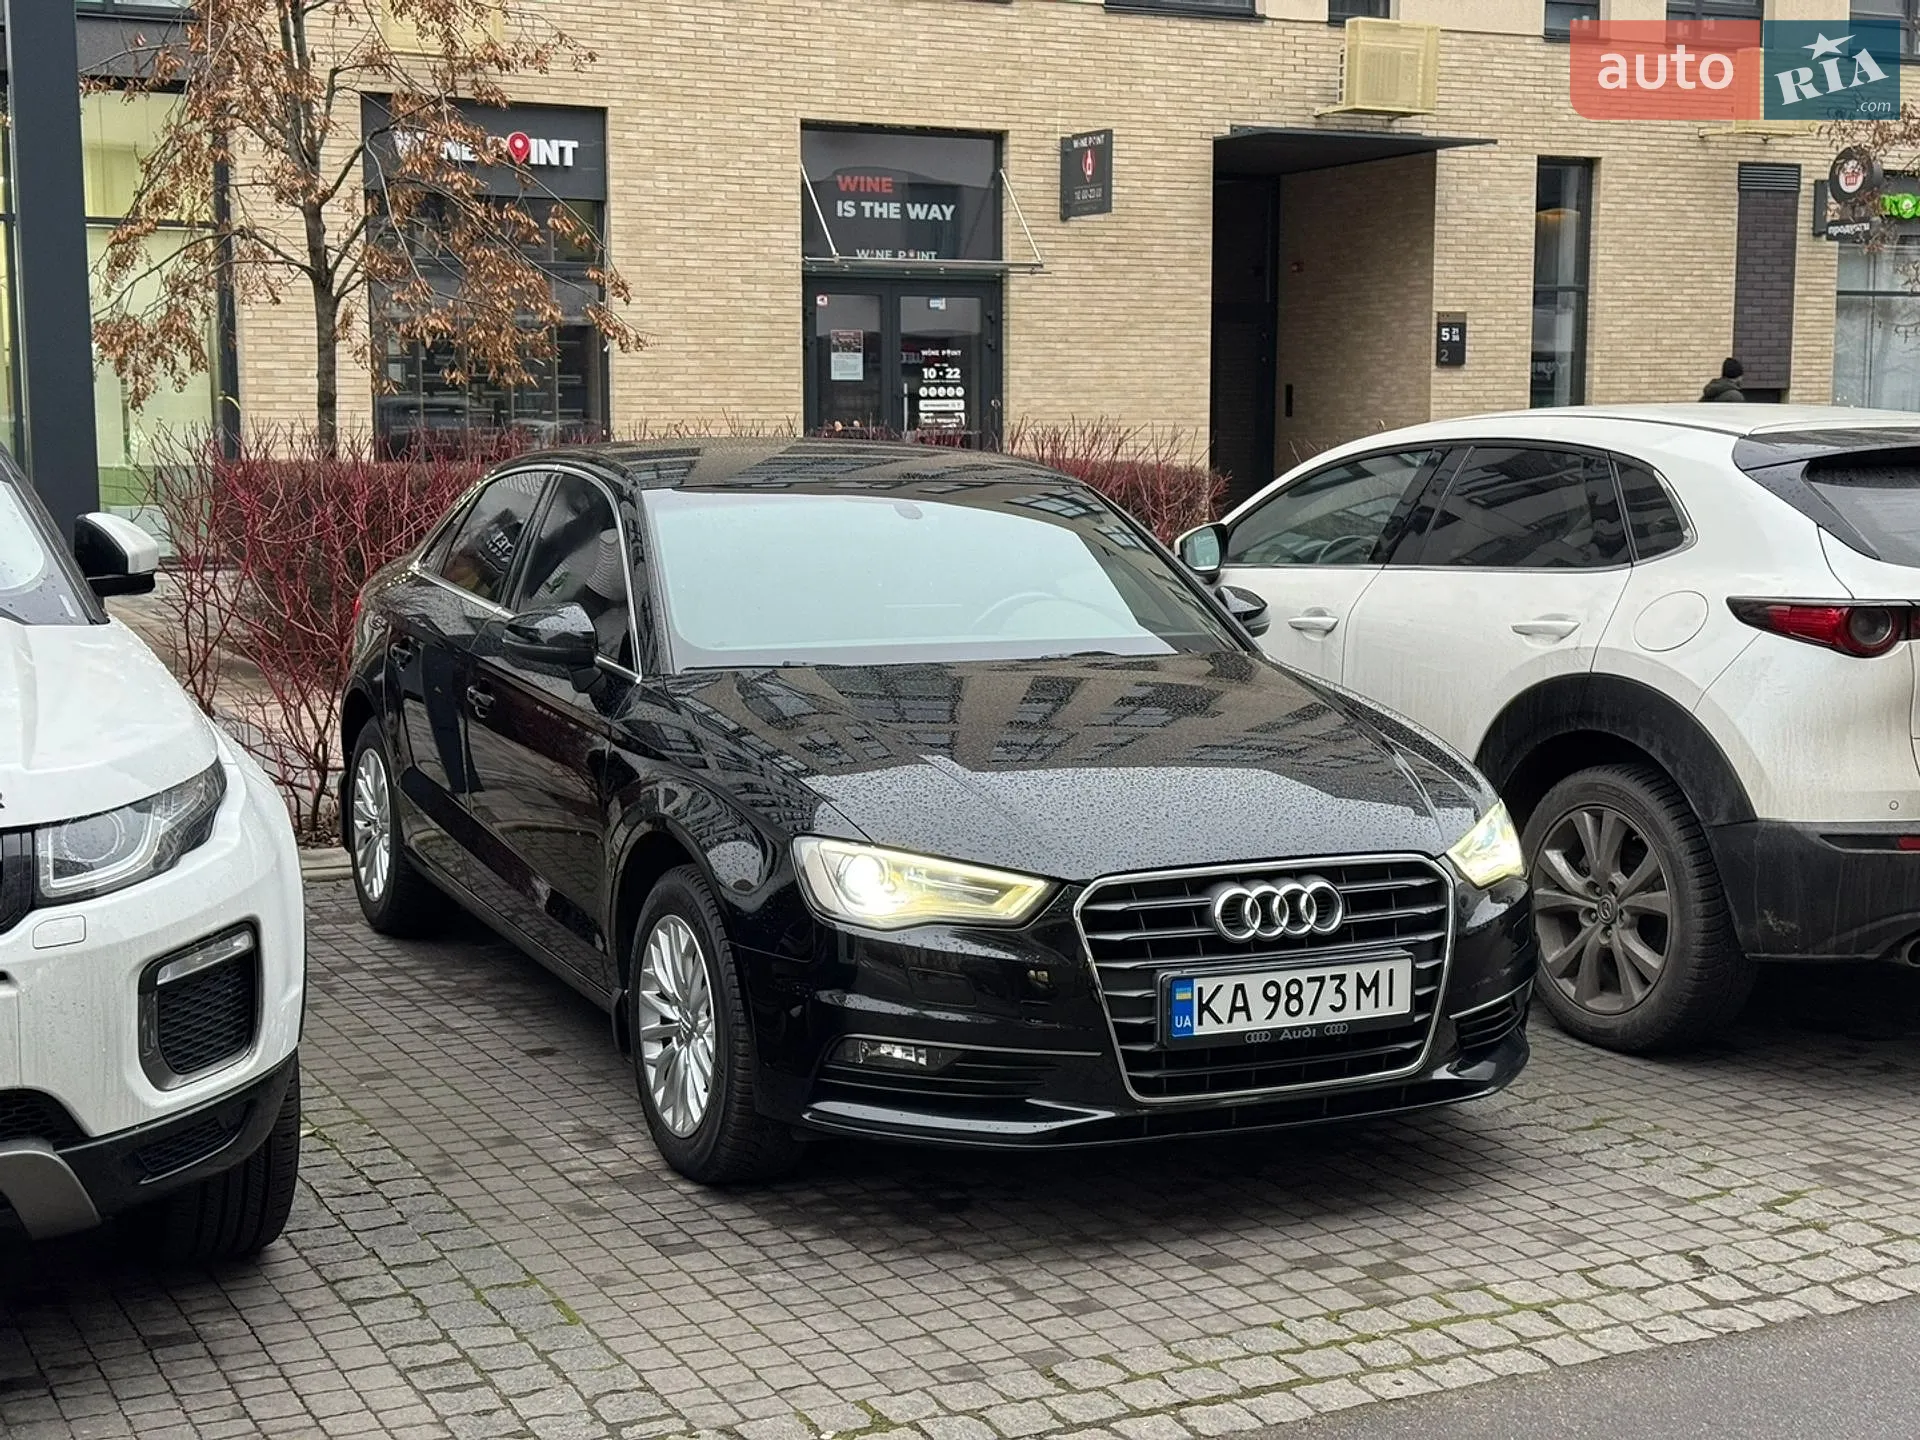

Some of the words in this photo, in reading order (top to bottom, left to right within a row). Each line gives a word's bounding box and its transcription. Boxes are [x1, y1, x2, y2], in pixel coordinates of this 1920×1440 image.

[837, 175, 893, 193] WINE
[837, 200, 856, 218] IS
[861, 202, 901, 219] THE
[906, 203, 956, 220] WAY
[1441, 327, 1450, 341] 5
[1440, 349, 1449, 362] 2
[922, 367, 937, 379] 10
[945, 367, 961, 379] 22
[1197, 983, 1252, 1026] KA
[1262, 973, 1347, 1020] 9873
[1355, 968, 1394, 1011] MI
[1175, 1015, 1191, 1028] UA
[1279, 1028, 1317, 1041] Audi
